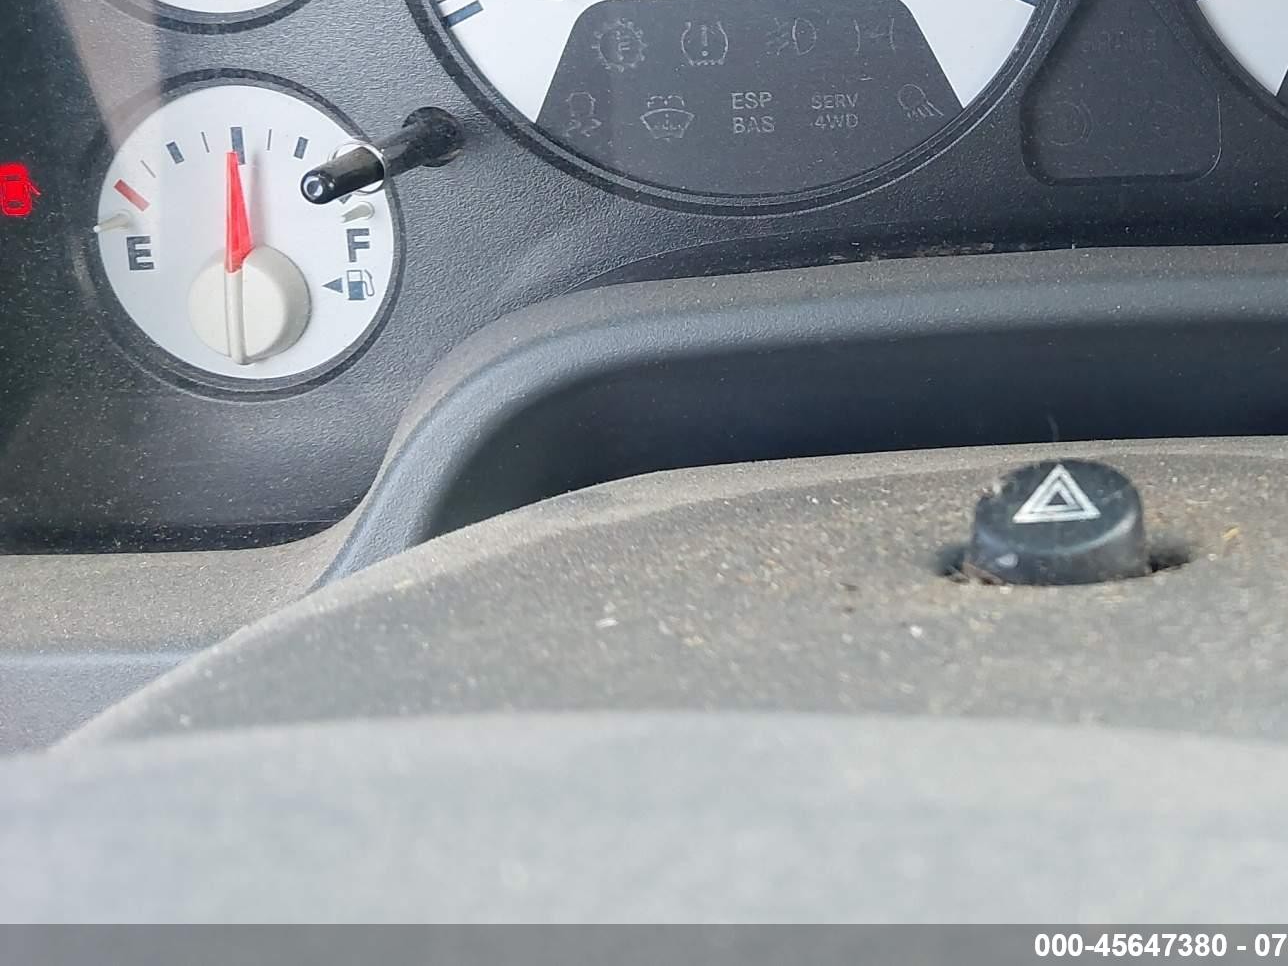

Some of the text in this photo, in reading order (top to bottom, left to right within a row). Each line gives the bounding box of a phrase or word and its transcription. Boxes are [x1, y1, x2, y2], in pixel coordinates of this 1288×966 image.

[732, 92, 772, 109] ESP
[811, 93, 858, 109] SERV
[733, 115, 775, 133] BAS
[814, 113, 858, 129] 4WD
[126, 236, 154, 270] E
[346, 228, 370, 262] F
